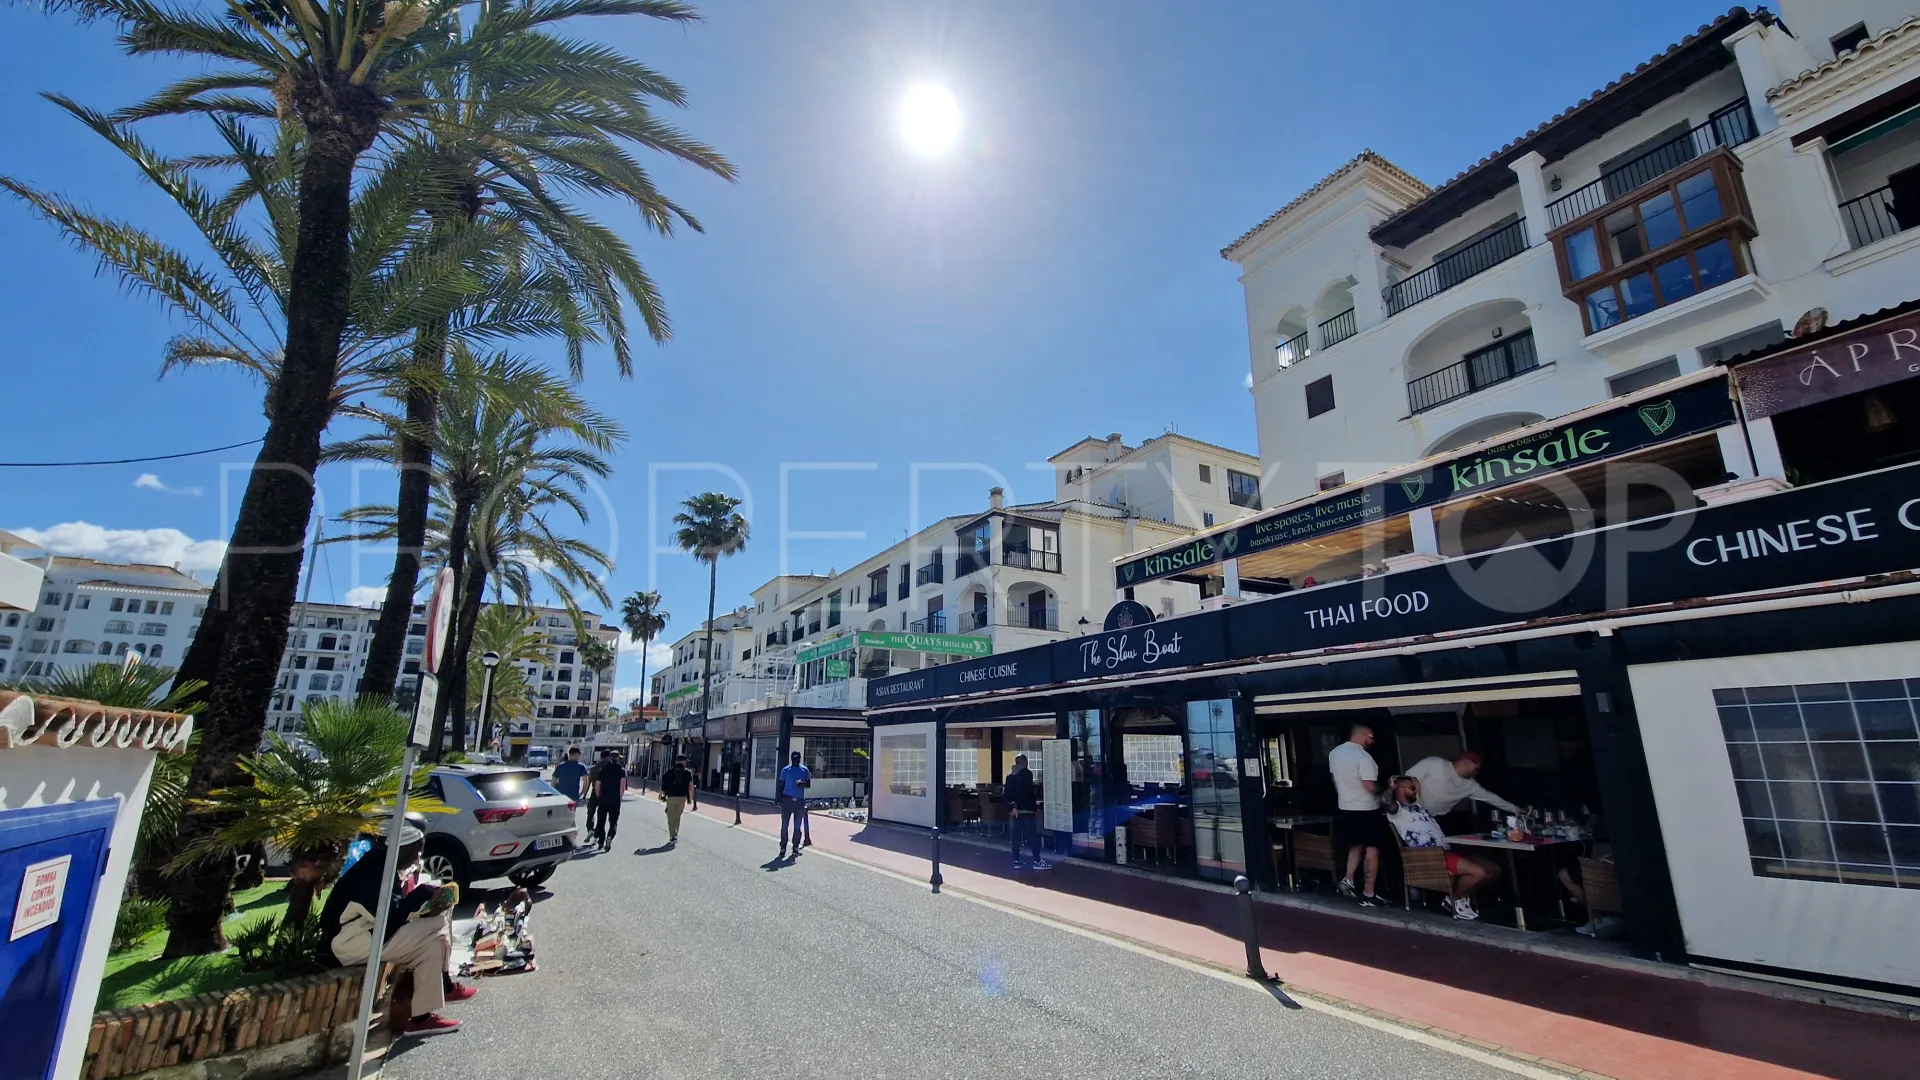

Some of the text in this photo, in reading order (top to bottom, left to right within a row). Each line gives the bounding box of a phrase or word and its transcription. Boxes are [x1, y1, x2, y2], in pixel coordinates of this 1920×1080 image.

[1448, 428, 1611, 491] kinsale
[1255, 522, 1273, 535] live
[1315, 504, 1335, 518] live
[1337, 493, 1372, 511] music
[1354, 505, 1382, 519] tapas
[1686, 507, 1880, 566] CHINESE
[1144, 542, 1215, 576] kinsale
[1304, 590, 1430, 629] THAI FOOD
[890, 635, 904, 644] THE
[904, 633, 942, 650] QUAYS
[942, 640, 960, 648] IRISH
[1079, 628, 1183, 673] The Slow Boat
[959, 662, 1018, 684] CHINESE CUISINE
[875, 678, 925, 697] ASIAN RESTAURANT
[35, 870, 57, 887] BOMBA
[31, 885, 55, 902] CONTRA
[23, 897, 56, 919] INCENDIOS
